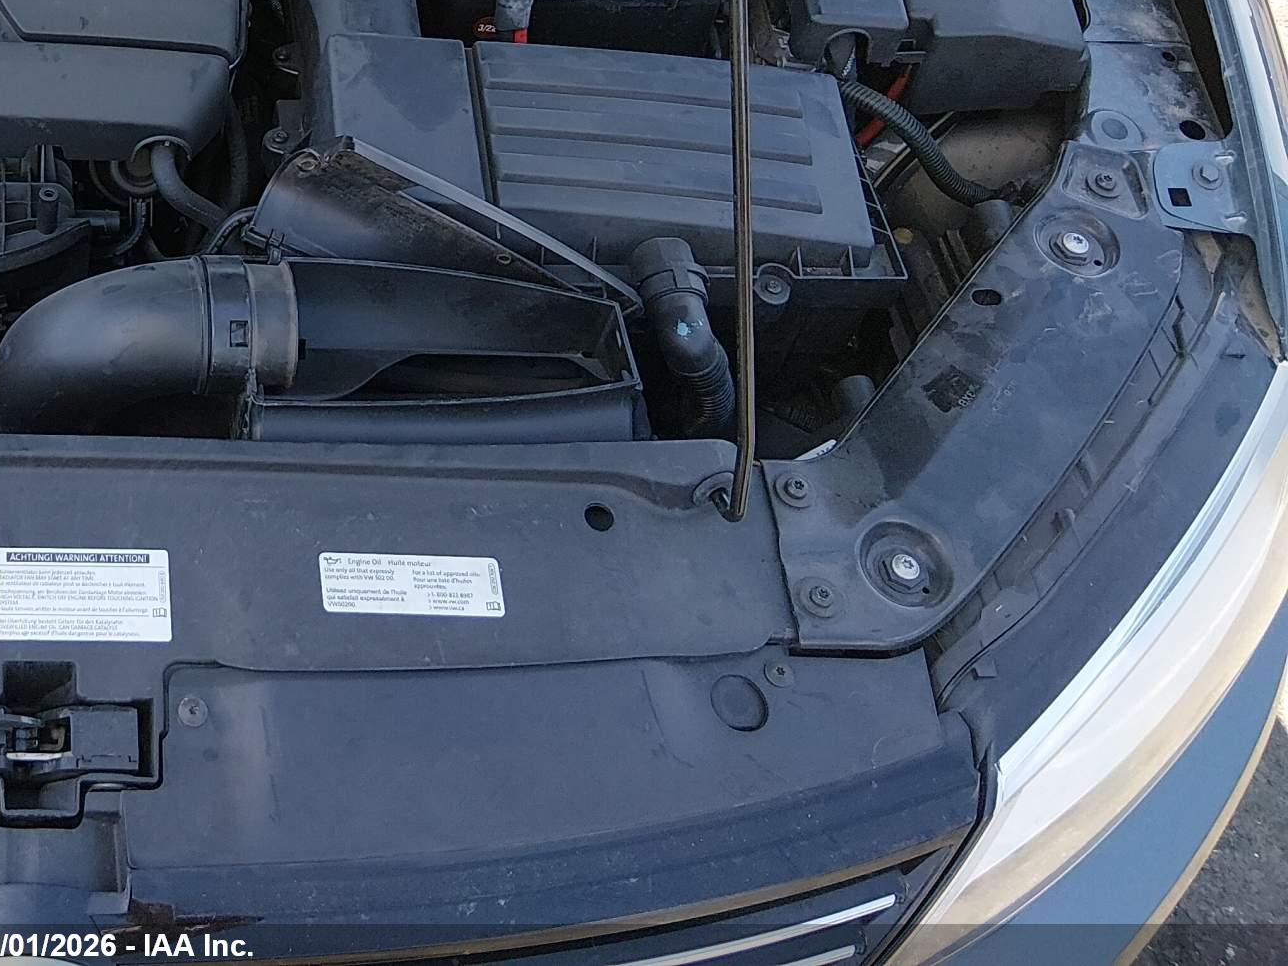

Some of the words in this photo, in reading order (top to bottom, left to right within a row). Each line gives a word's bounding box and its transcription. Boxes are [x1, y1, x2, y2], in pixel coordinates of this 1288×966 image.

[9, 553, 53, 561] ACHTUNG!
[55, 553, 98, 562] WARNING!
[99, 554, 148, 563] ATTENTION!
[348, 558, 371, 566] Engine
